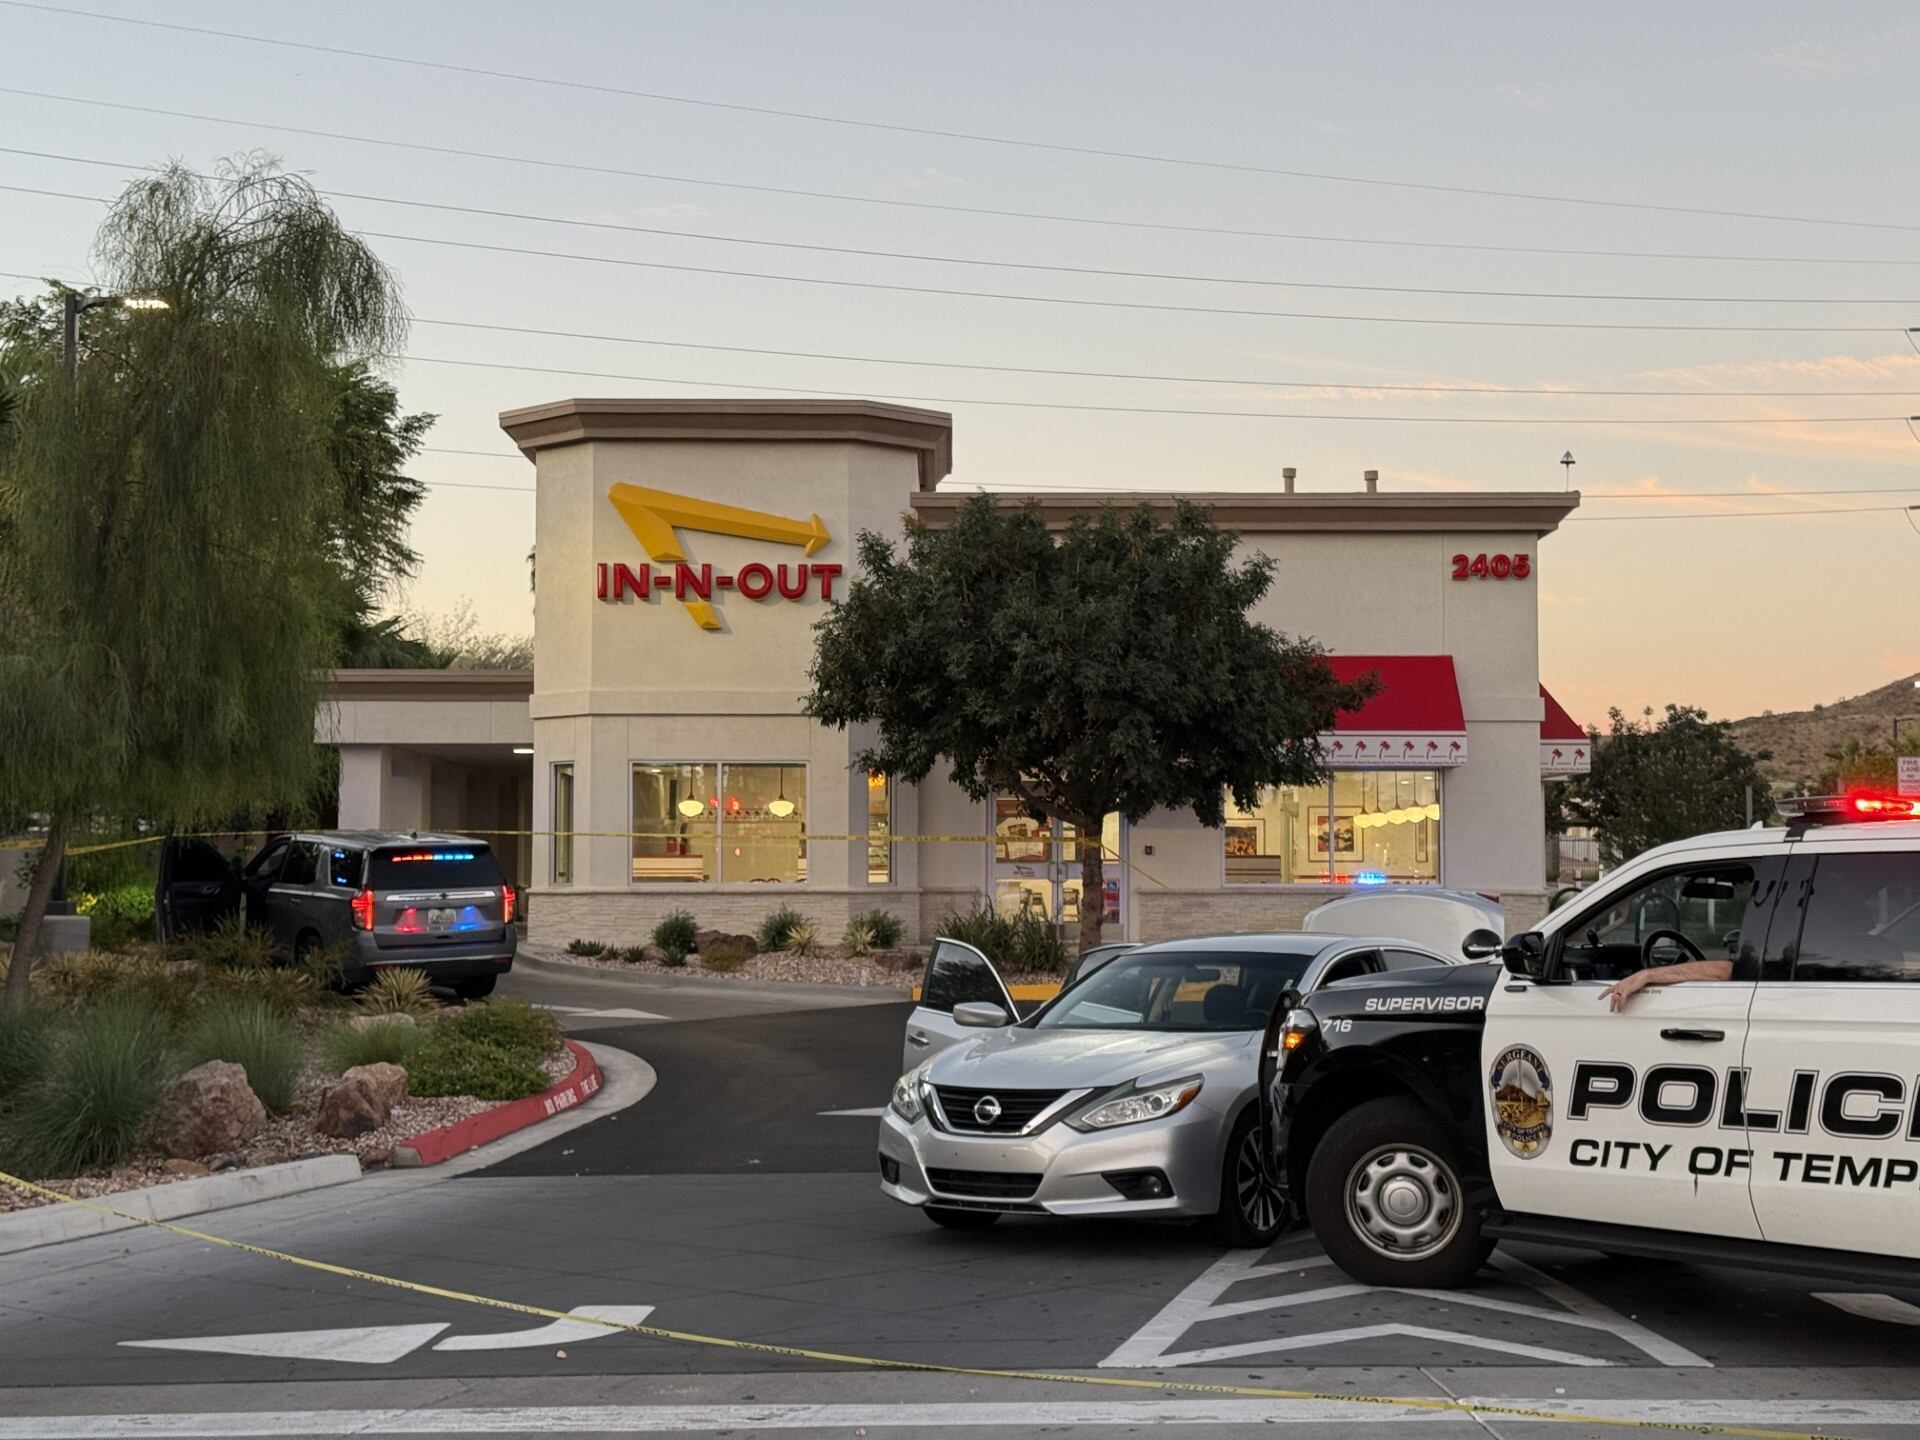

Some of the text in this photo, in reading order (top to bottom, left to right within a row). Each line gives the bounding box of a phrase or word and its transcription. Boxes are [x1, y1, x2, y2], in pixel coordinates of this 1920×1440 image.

[1452, 553, 1531, 581] 2405
[597, 562, 843, 601] IN-N-OUT
[1365, 996, 1485, 1011] SUPERVISOR
[1322, 1019, 1353, 1033] 716
[1496, 1049, 1544, 1074] SERGEANT
[1567, 1060, 1920, 1142] POLIC
[1569, 1138, 1920, 1189] CITY OF TEMP
